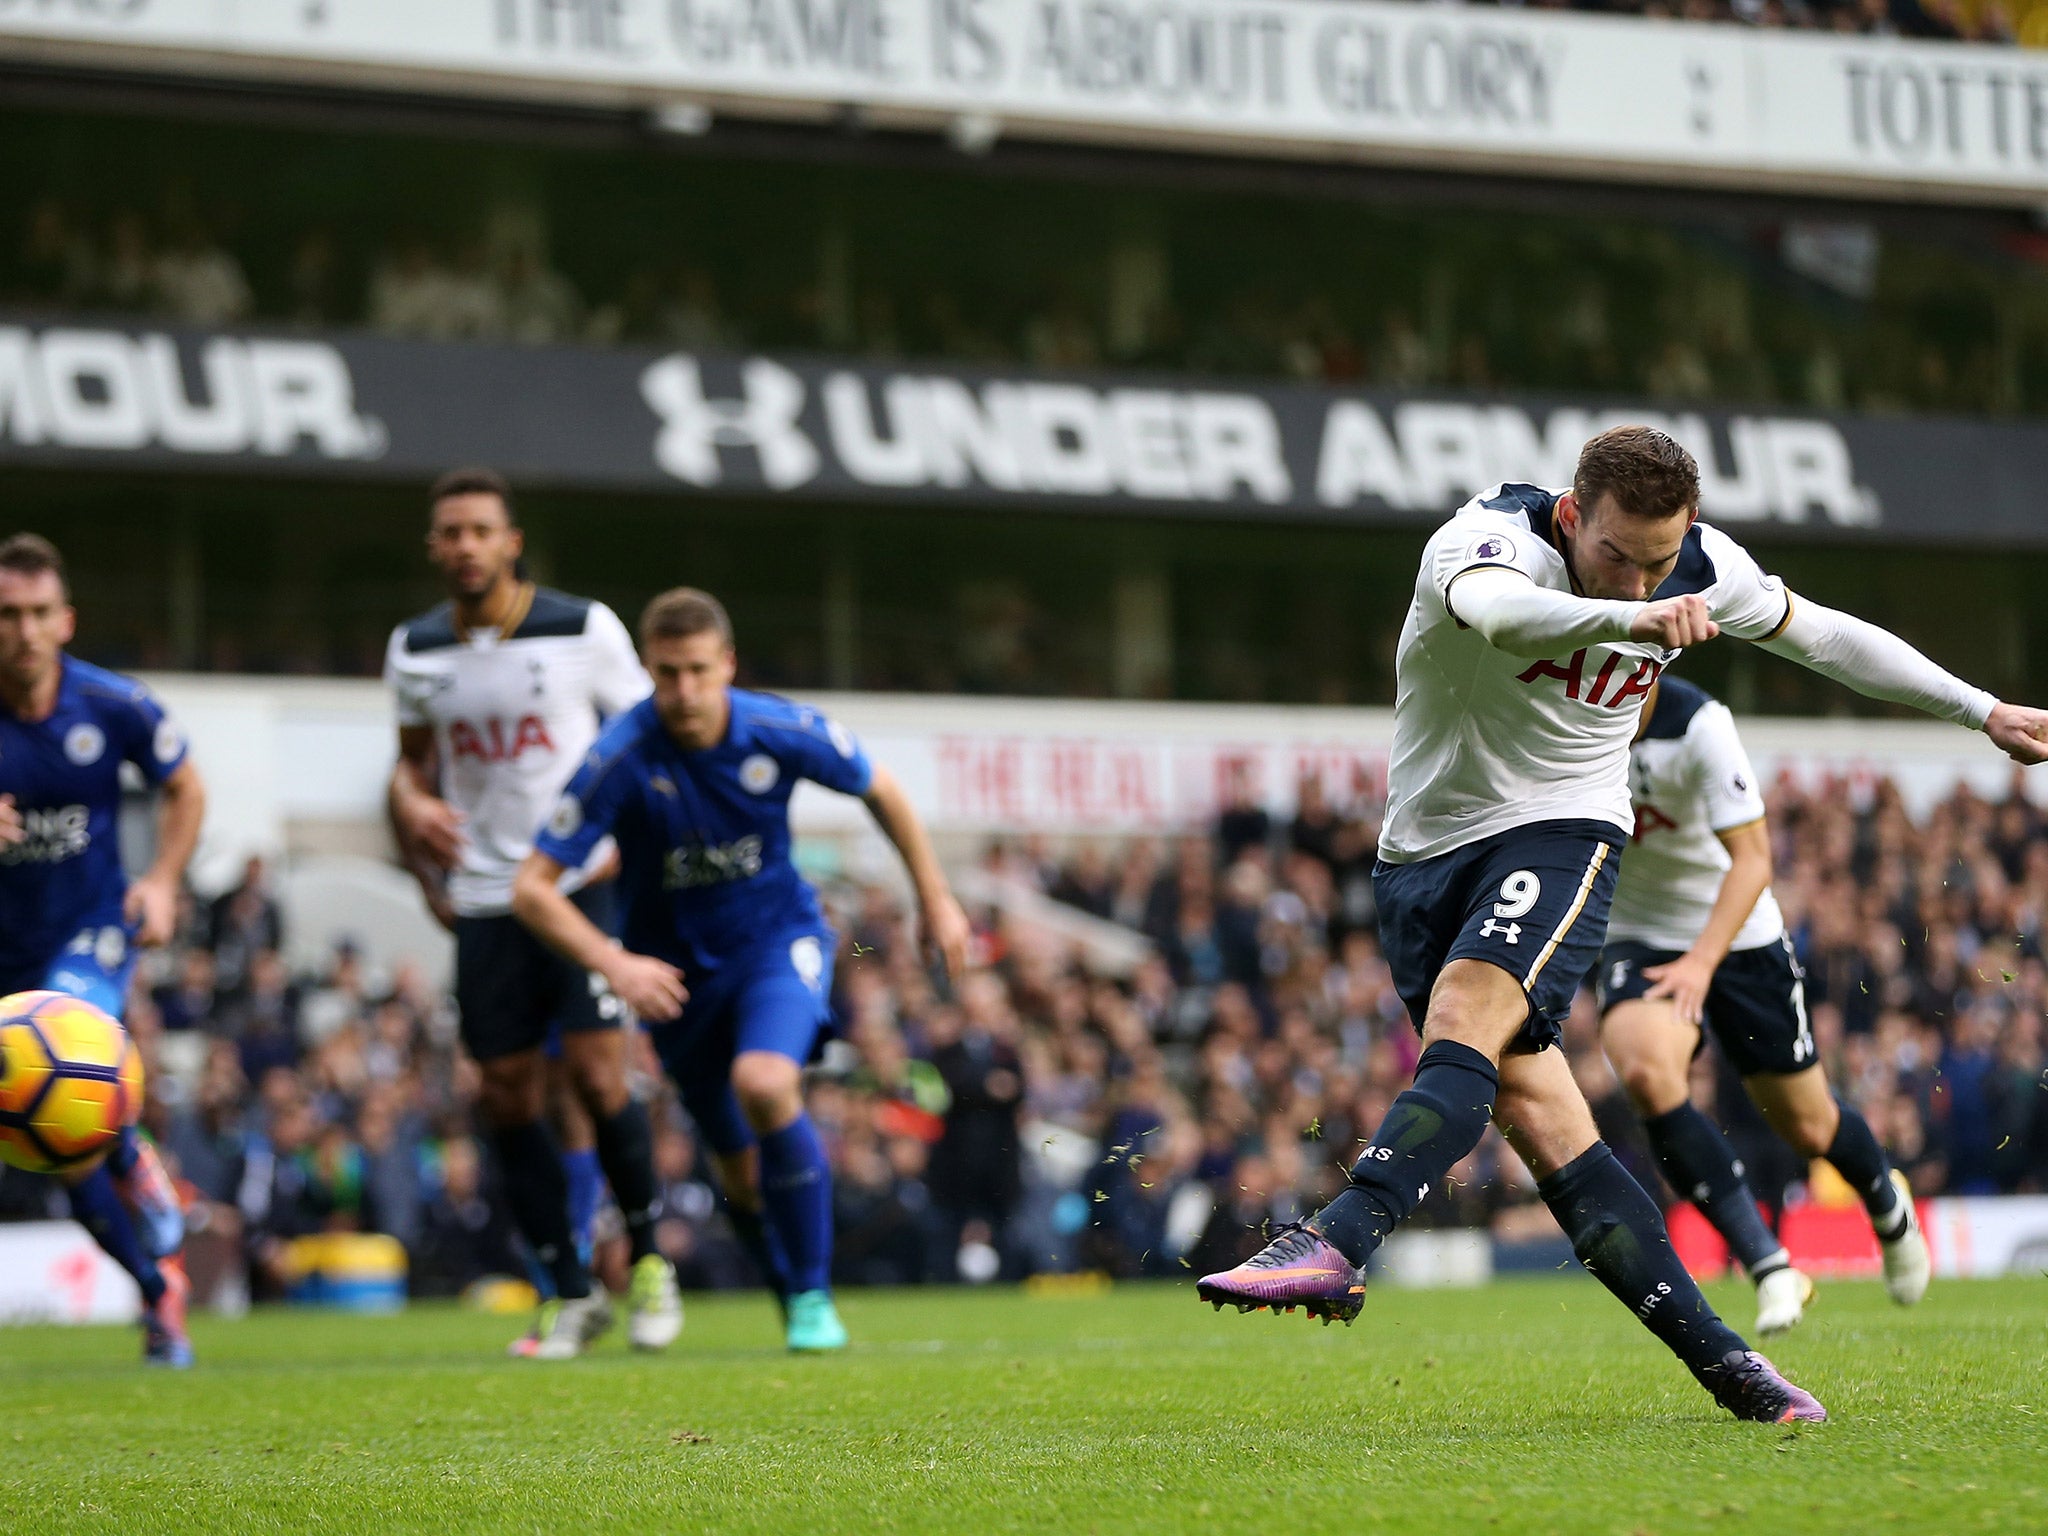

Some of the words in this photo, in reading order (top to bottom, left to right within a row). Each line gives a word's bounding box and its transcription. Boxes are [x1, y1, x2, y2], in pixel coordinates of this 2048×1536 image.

[929, 0, 1006, 86] IS
[1022, 2, 1294, 112] ABOUT
[1312, 12, 1564, 132] GLORY
[822, 372, 1292, 504] UNDER
[1316, 400, 1860, 528] ARMUR
[1515, 646, 1662, 708] AIA
[448, 711, 557, 763] AIA
[1494, 869, 1541, 918] 9
